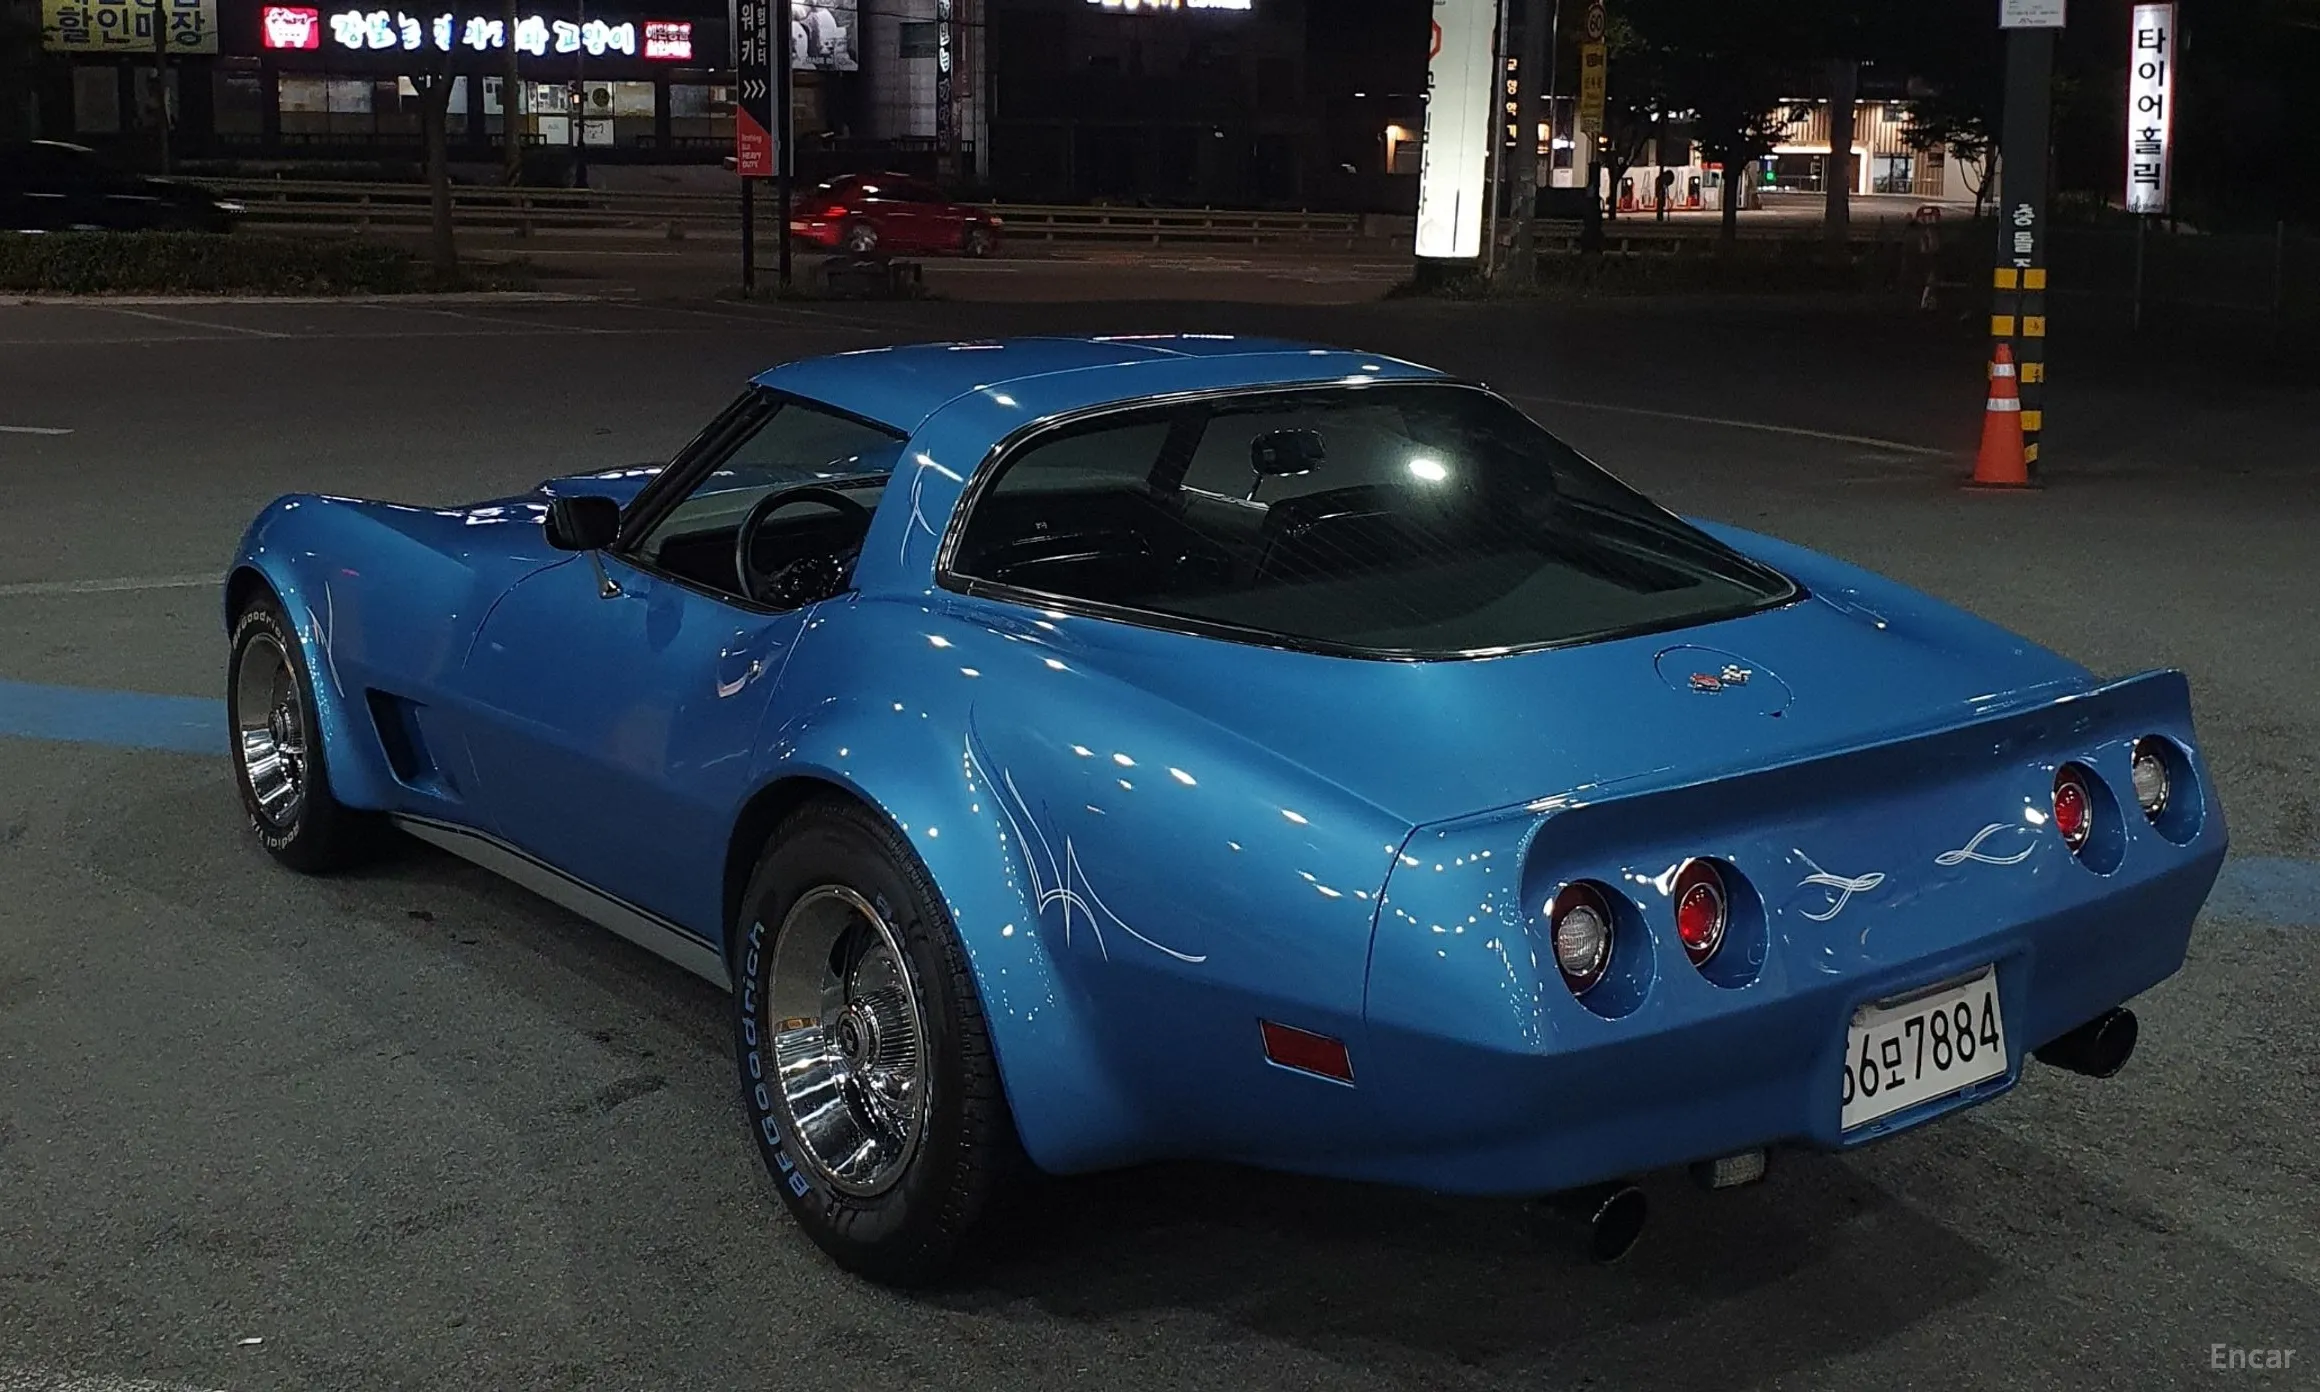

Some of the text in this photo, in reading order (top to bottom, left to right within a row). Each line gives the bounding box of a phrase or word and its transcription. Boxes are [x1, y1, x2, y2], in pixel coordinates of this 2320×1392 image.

[553, 19, 636, 56] 고양이
[756, 0, 768, 66] 험센터
[1590, 13, 1603, 32] 60
[2134, 27, 2166, 190] 타이어홀릭
[742, 921, 810, 1198] BFGoodrich
